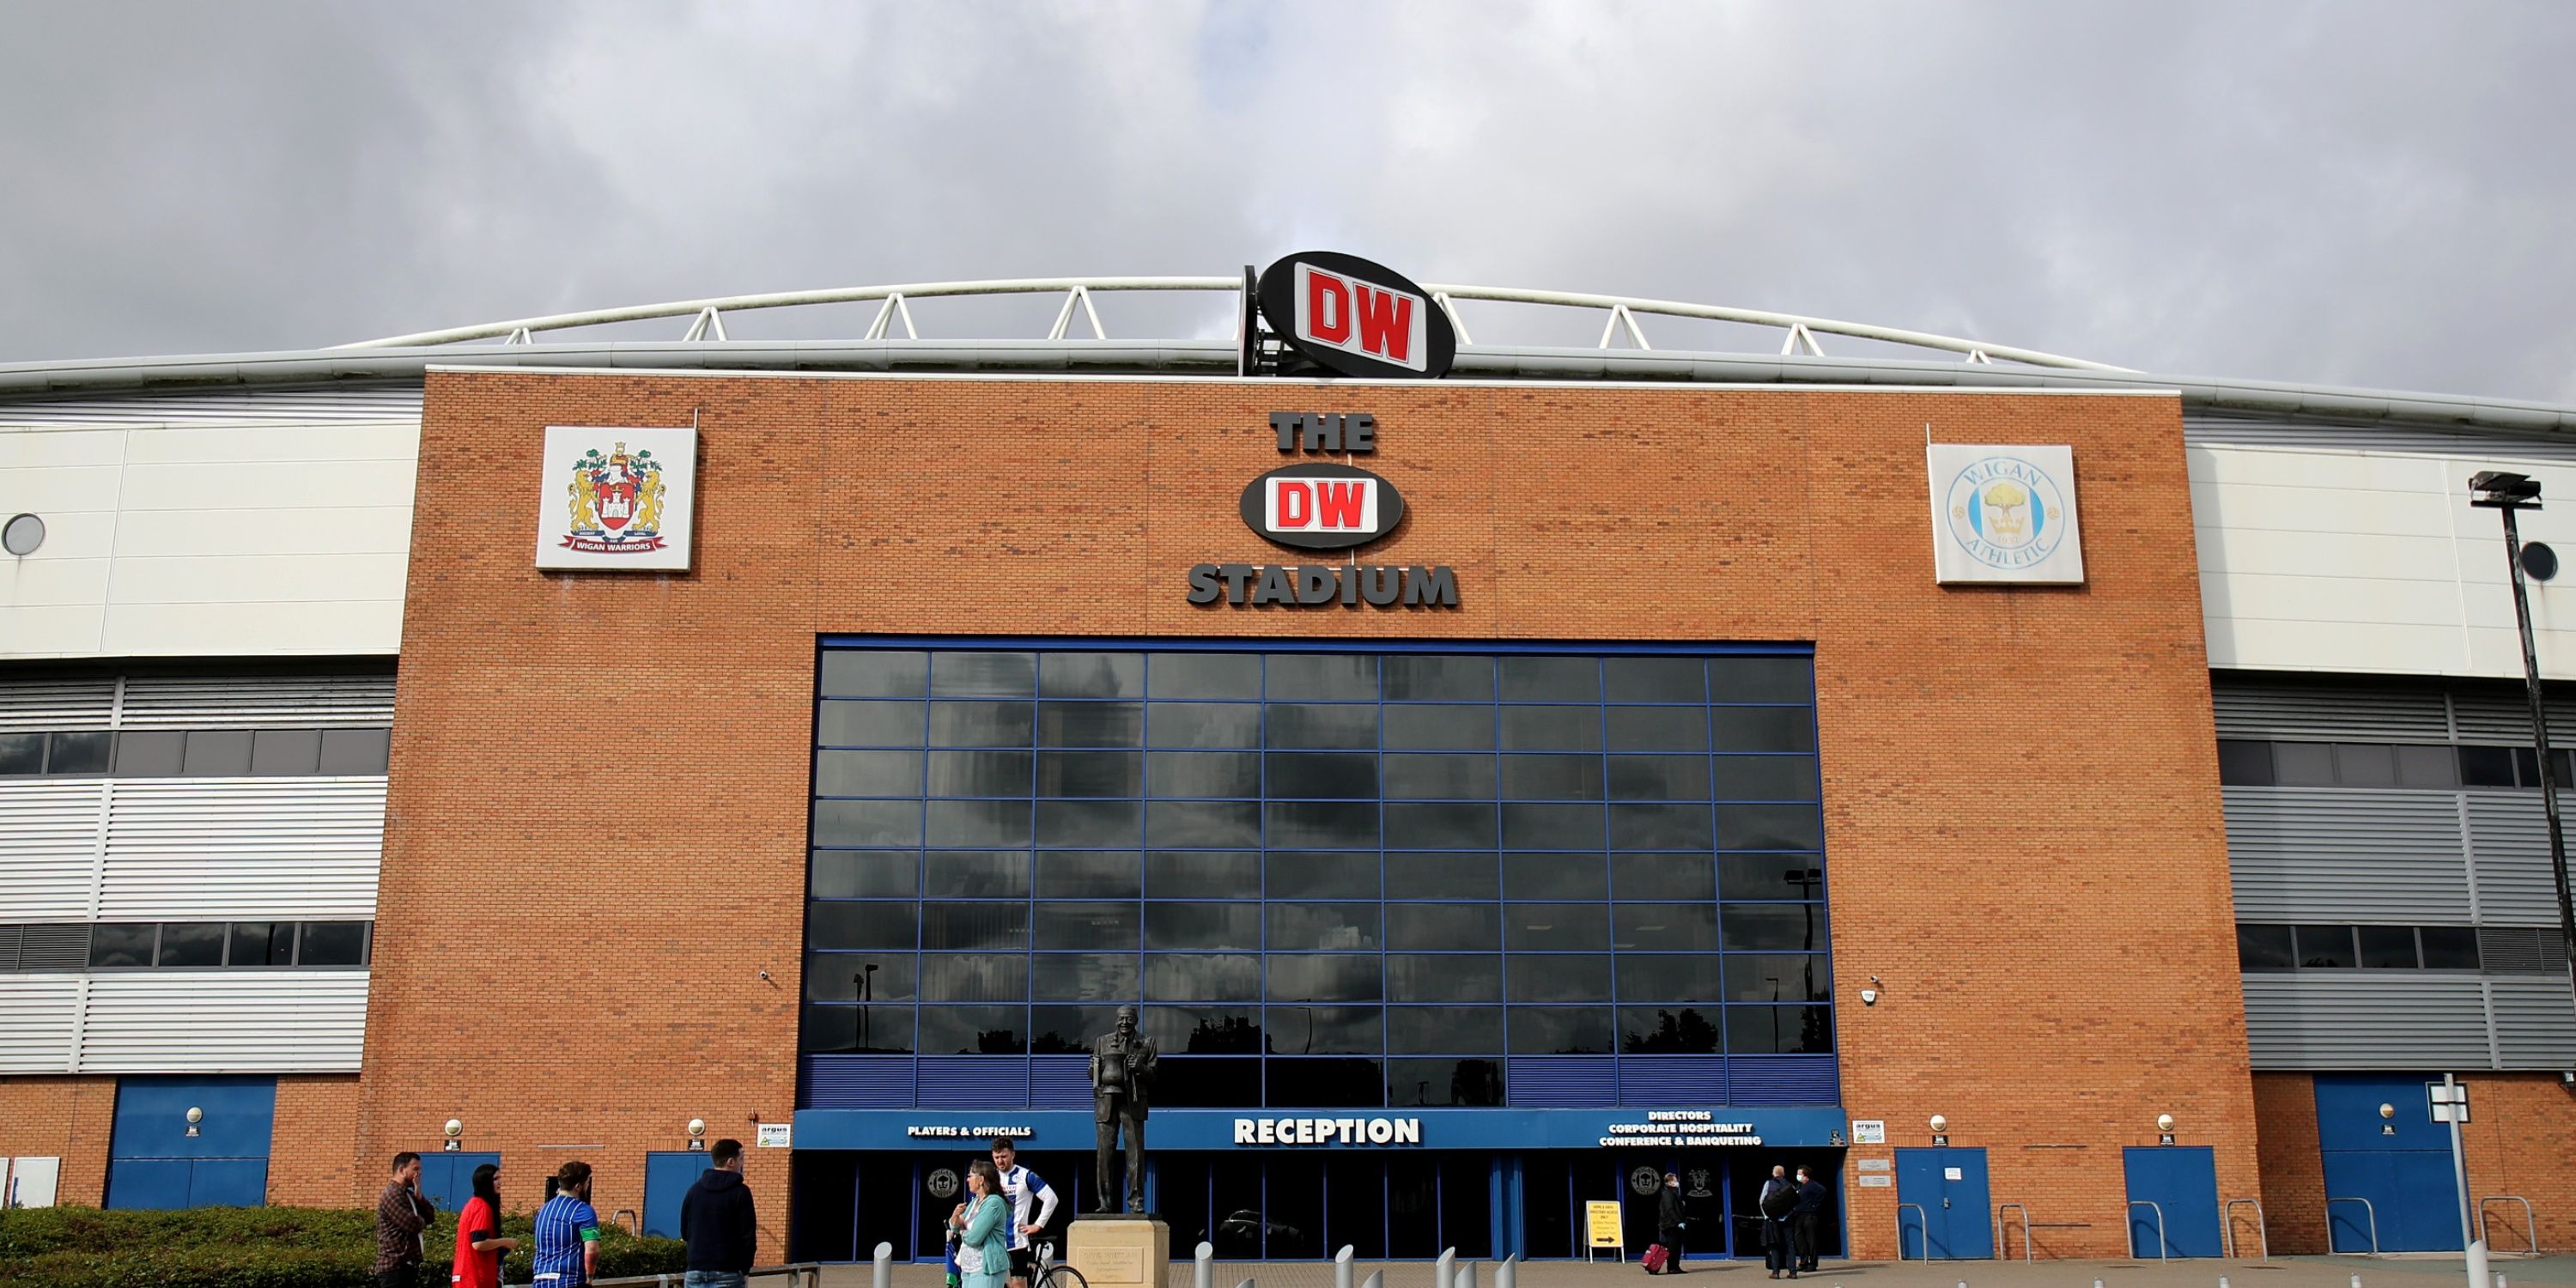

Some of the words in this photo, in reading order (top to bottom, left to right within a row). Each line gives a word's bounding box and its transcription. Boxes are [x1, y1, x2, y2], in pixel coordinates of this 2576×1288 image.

[1307, 268, 1415, 364] DW
[1269, 411, 1374, 452] THE
[1963, 463, 2042, 488] WIGAN
[1275, 480, 1367, 530] DW
[576, 542, 605, 551] WIGAN
[607, 542, 651, 552] WARRIORS
[1966, 538, 2050, 565] ATHLETIC
[1187, 563, 1458, 605] STADIUM
[1608, 1124, 1677, 1133] CORPORATE
[1679, 1123, 1753, 1133] HOSPITALITY
[1648, 1111, 1711, 1121] DIRECTORS
[908, 1126, 957, 1136] PLAYERS
[960, 1127, 969, 1136] &
[972, 1127, 1031, 1136] OFFICIALS
[1234, 1118, 1419, 1144] RECEPTION
[1599, 1137, 1672, 1146] CONFERENCE
[1674, 1137, 1684, 1145] &
[1686, 1136, 1762, 1146] BANQUETING
